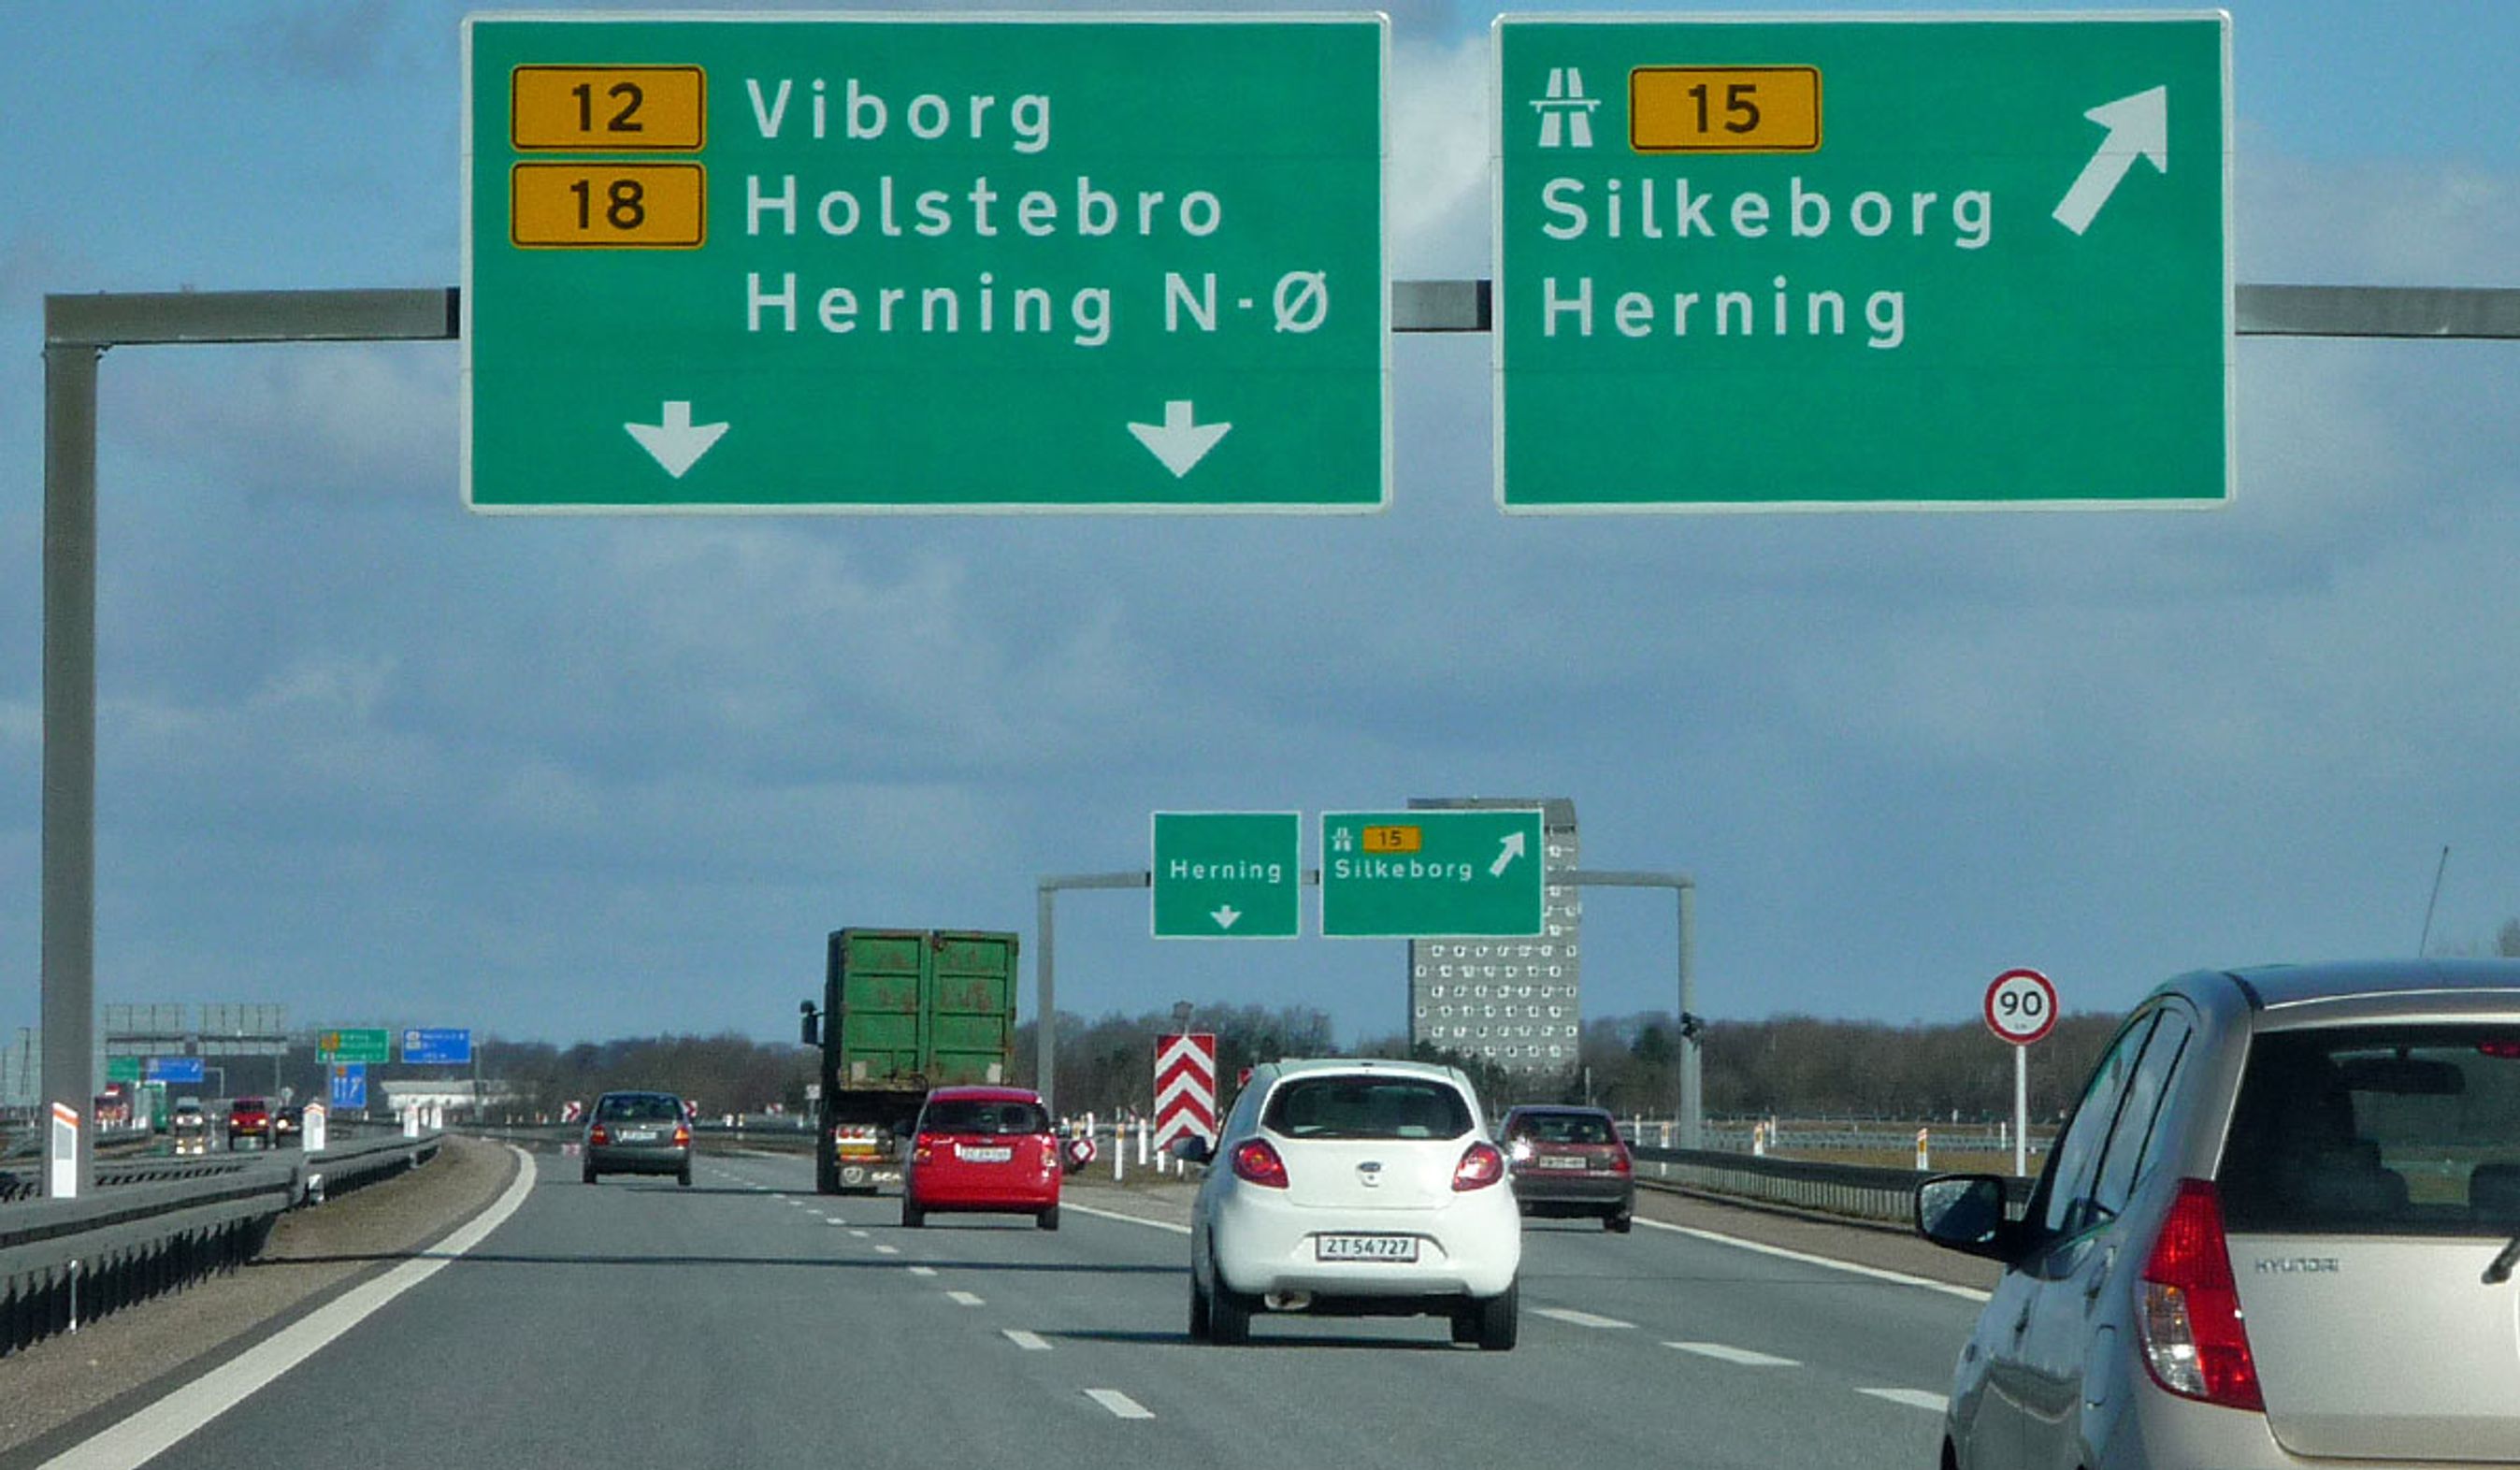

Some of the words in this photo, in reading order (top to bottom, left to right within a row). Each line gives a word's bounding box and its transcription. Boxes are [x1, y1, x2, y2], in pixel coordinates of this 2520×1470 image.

[572, 82, 644, 133] 12
[746, 79, 1050, 153] Viborg
[1688, 83, 1761, 134] 15
[570, 180, 645, 230] 18
[747, 175, 1221, 237] Holstebro
[1542, 177, 1992, 249] Silkeborg
[747, 272, 1112, 346] Herning
[1164, 269, 1329, 334] N-Ø
[1543, 276, 1904, 349] Herning
[1378, 830, 1403, 846] 15
[1171, 859, 1281, 884] Herning
[1335, 858, 1473, 881] Silkeborg
[2000, 991, 2042, 1016] 90
